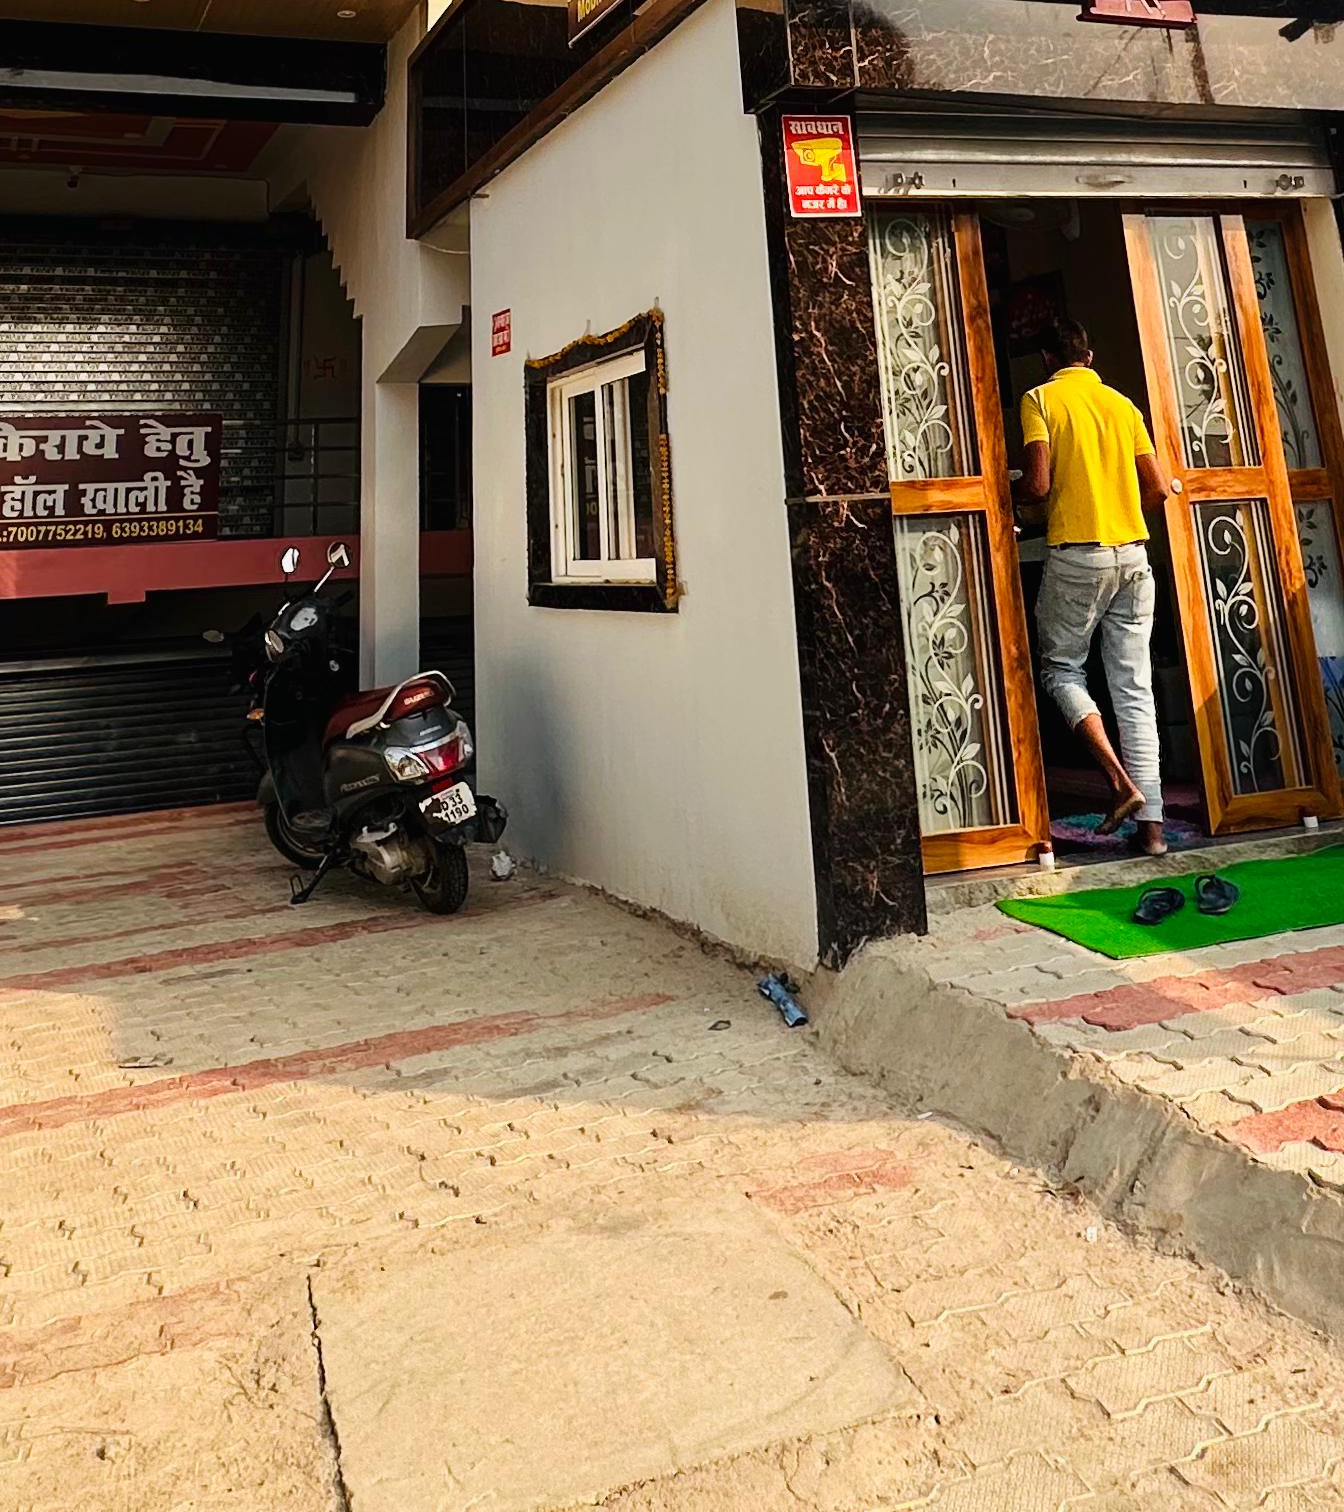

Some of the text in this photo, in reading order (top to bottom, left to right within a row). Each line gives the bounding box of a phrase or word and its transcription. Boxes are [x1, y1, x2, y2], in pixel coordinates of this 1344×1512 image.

[138, 419, 212, 468] हेतु
[0, 475, 69, 518] हॉल
[78, 472, 172, 515] खाली
[178, 470, 205, 510] है
[112, 519, 204, 540] 6393389134
